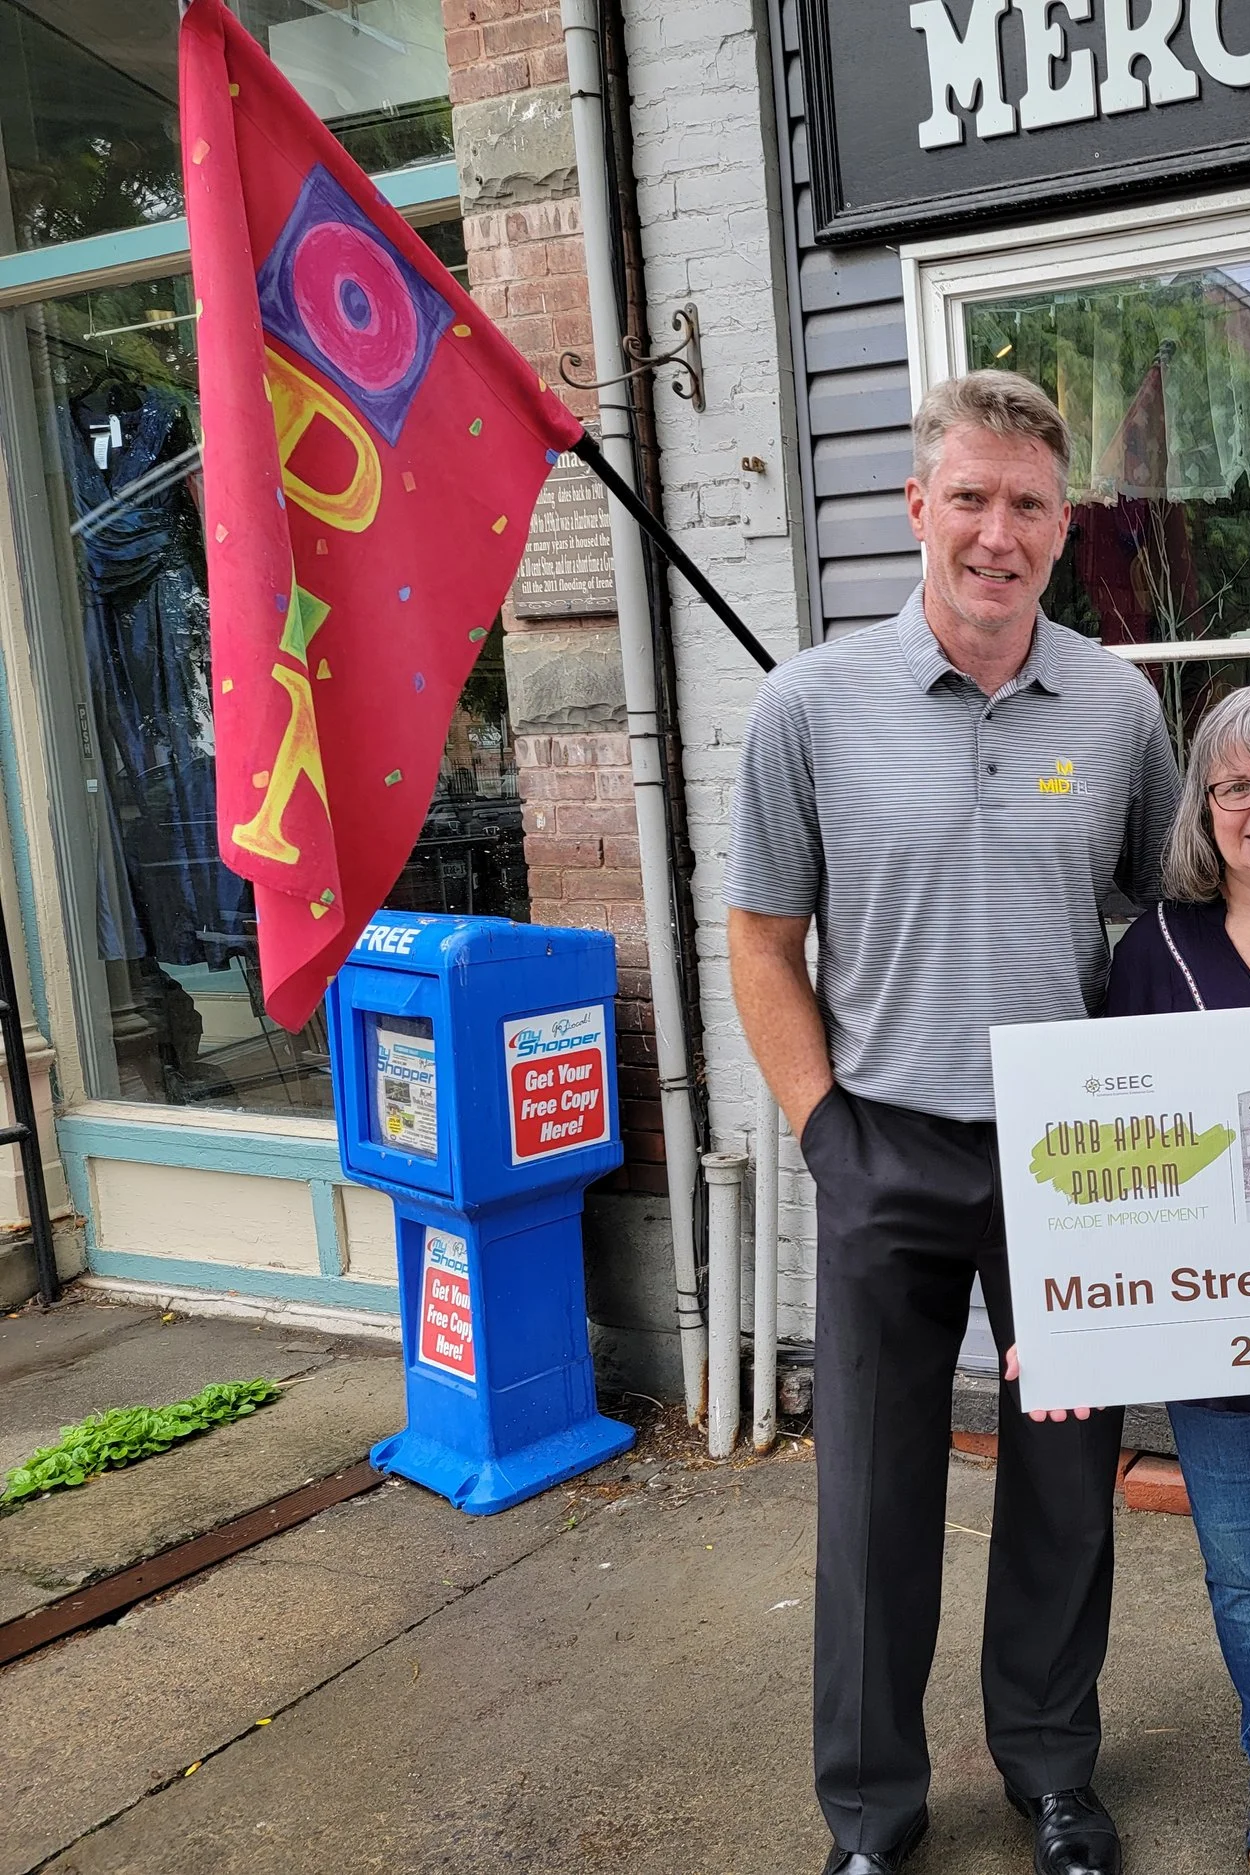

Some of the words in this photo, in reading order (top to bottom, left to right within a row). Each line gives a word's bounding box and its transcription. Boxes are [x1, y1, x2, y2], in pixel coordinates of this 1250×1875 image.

[533, 542, 550, 555] many
[550, 540, 568, 554] years
[568, 535, 574, 548] it
[574, 534, 598, 548] housed
[598, 532, 610, 546] the
[521, 580, 532, 594] till
[532, 580, 543, 593] the
[543, 579, 557, 592] 2011
[558, 577, 587, 594] flooding
[587, 576, 595, 590] of
[595, 576, 613, 589] Irene
[79, 708, 91, 754] PUSH
[1039, 778, 1093, 795] MIDTEL
[355, 924, 421, 955] FREE
[517, 1032, 601, 1057] Shopper
[525, 1069, 554, 1092] Get
[558, 1063, 593, 1085] Your
[1104, 1074, 1153, 1090] SEEC
[521, 1098, 557, 1120] Free
[561, 1088, 599, 1112] Copy
[540, 1115, 584, 1143] Here!
[1045, 1118, 1101, 1157] CURB
[1114, 1111, 1199, 1152] APPEAL
[1071, 1162, 1181, 1205] PROGRAM
[1048, 1213, 1103, 1231] FACADE
[1107, 1206, 1209, 1226] IMPROVEMENT
[431, 1278, 450, 1302] Get
[1043, 1272, 1154, 1312] Main
[427, 1303, 449, 1329] Free
[436, 1333, 464, 1361] Here!
